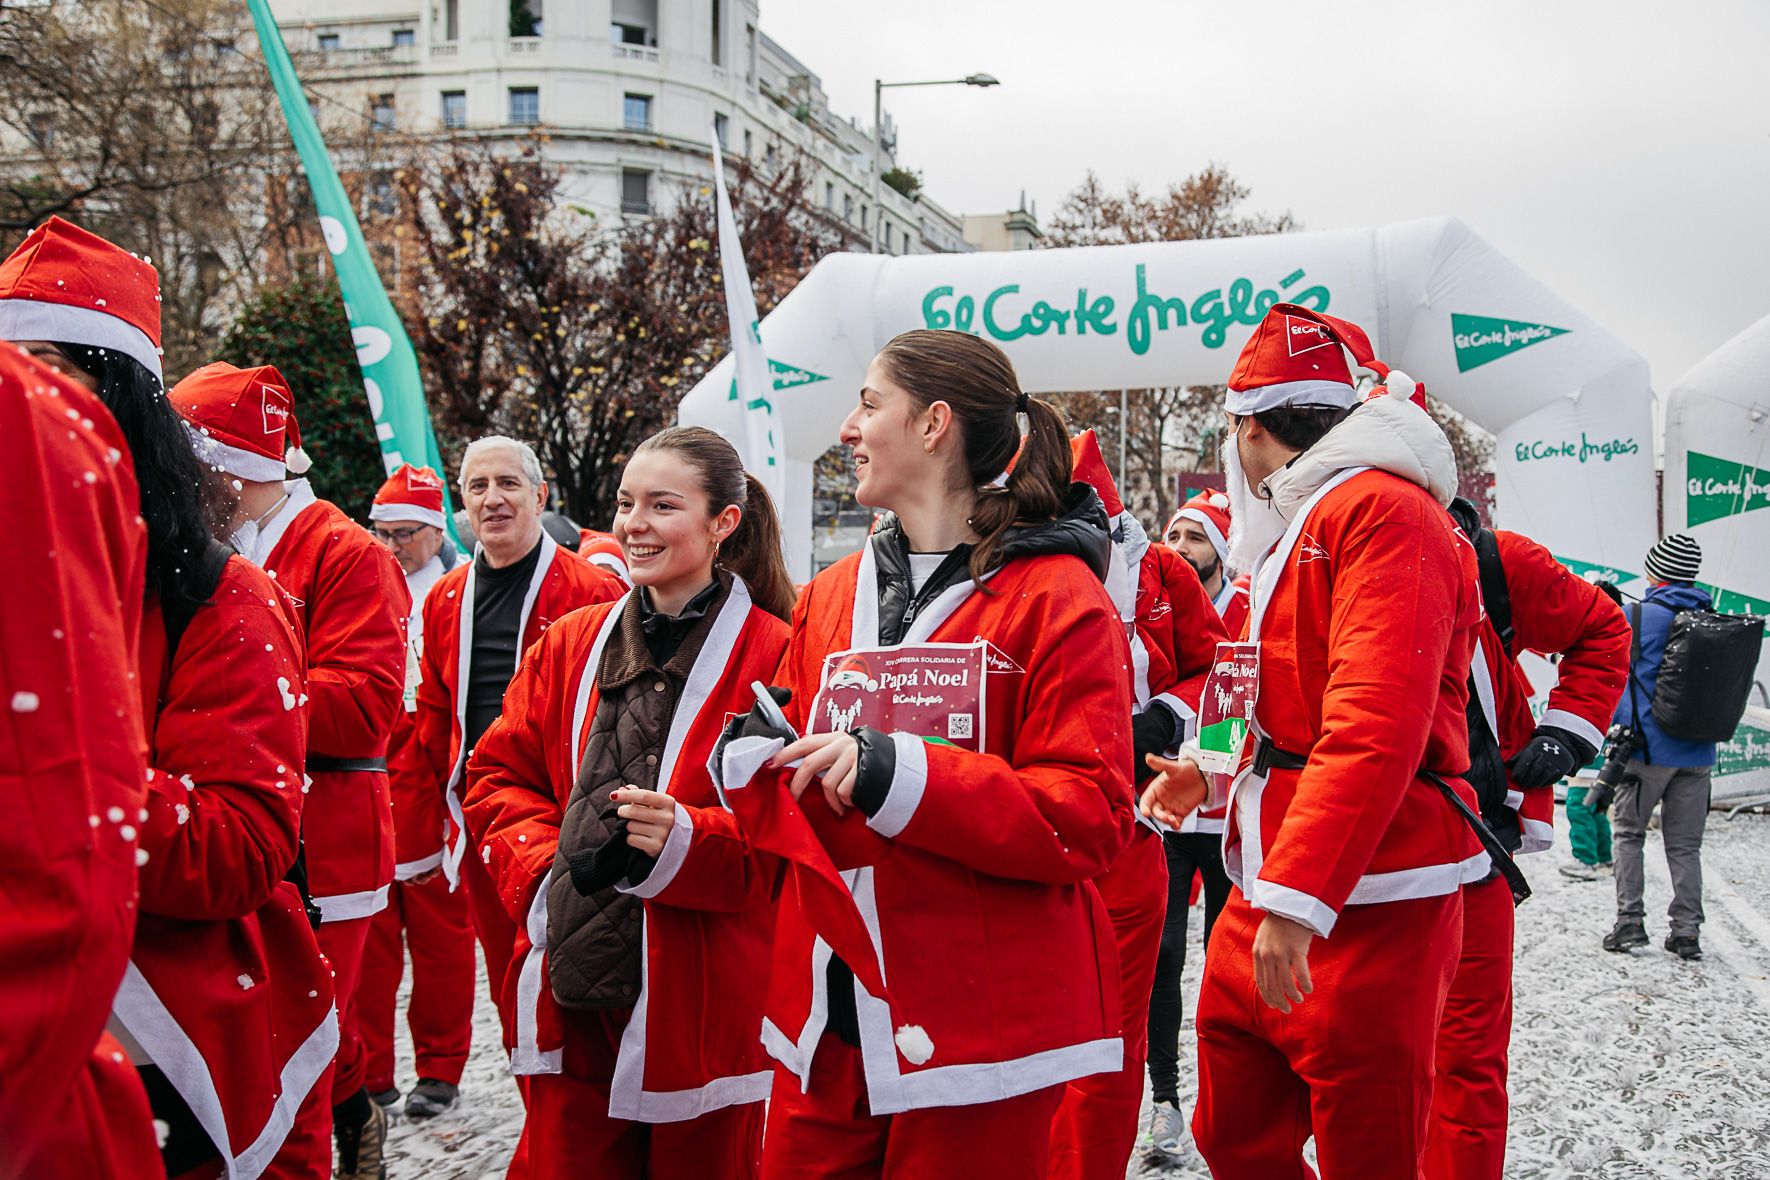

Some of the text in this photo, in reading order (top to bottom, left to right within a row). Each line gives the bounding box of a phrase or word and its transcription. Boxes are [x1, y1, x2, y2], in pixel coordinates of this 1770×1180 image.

[922, 263, 1331, 356] El Corte Inglés
[1455, 324, 1552, 350] El Corte Inglés
[1515, 432, 1639, 463] El Corte Inglés
[1688, 472, 1770, 501] El Corte Ing
[920, 656, 956, 664] SOLIDARIA
[1240, 663, 1258, 678] Noel
[878, 668, 969, 692] Papá Noel
